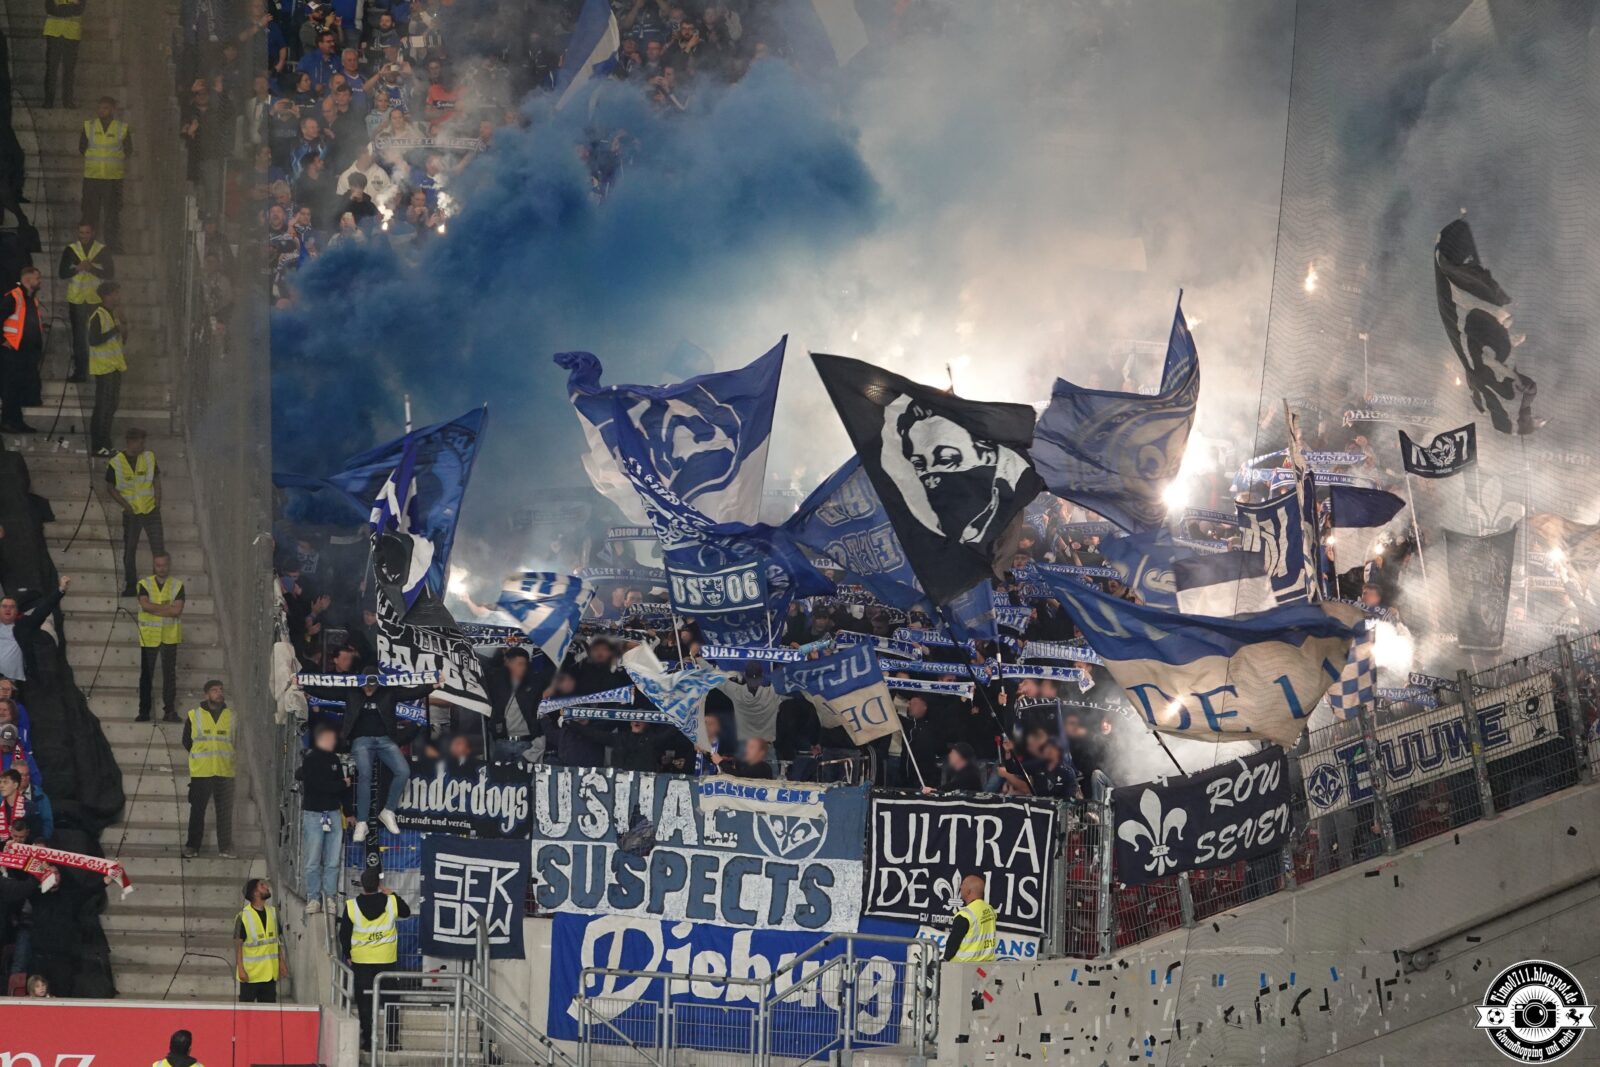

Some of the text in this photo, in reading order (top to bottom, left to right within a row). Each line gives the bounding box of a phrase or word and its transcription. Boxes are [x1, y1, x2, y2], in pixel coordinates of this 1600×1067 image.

[1454, 430, 1469, 461] 7
[671, 571, 761, 605] US 06
[701, 645, 740, 658] SUAL
[298, 672, 436, 687] UNDER DOGS
[571, 710, 670, 722] USUAL SUSPECT
[411, 816, 431, 825] stadt
[432, 817, 447, 826] und
[448, 819, 471, 829] verein
[536, 843, 835, 931] SUSPECTS
[876, 867, 931, 910] DE
[994, 938, 1036, 958] ANS
